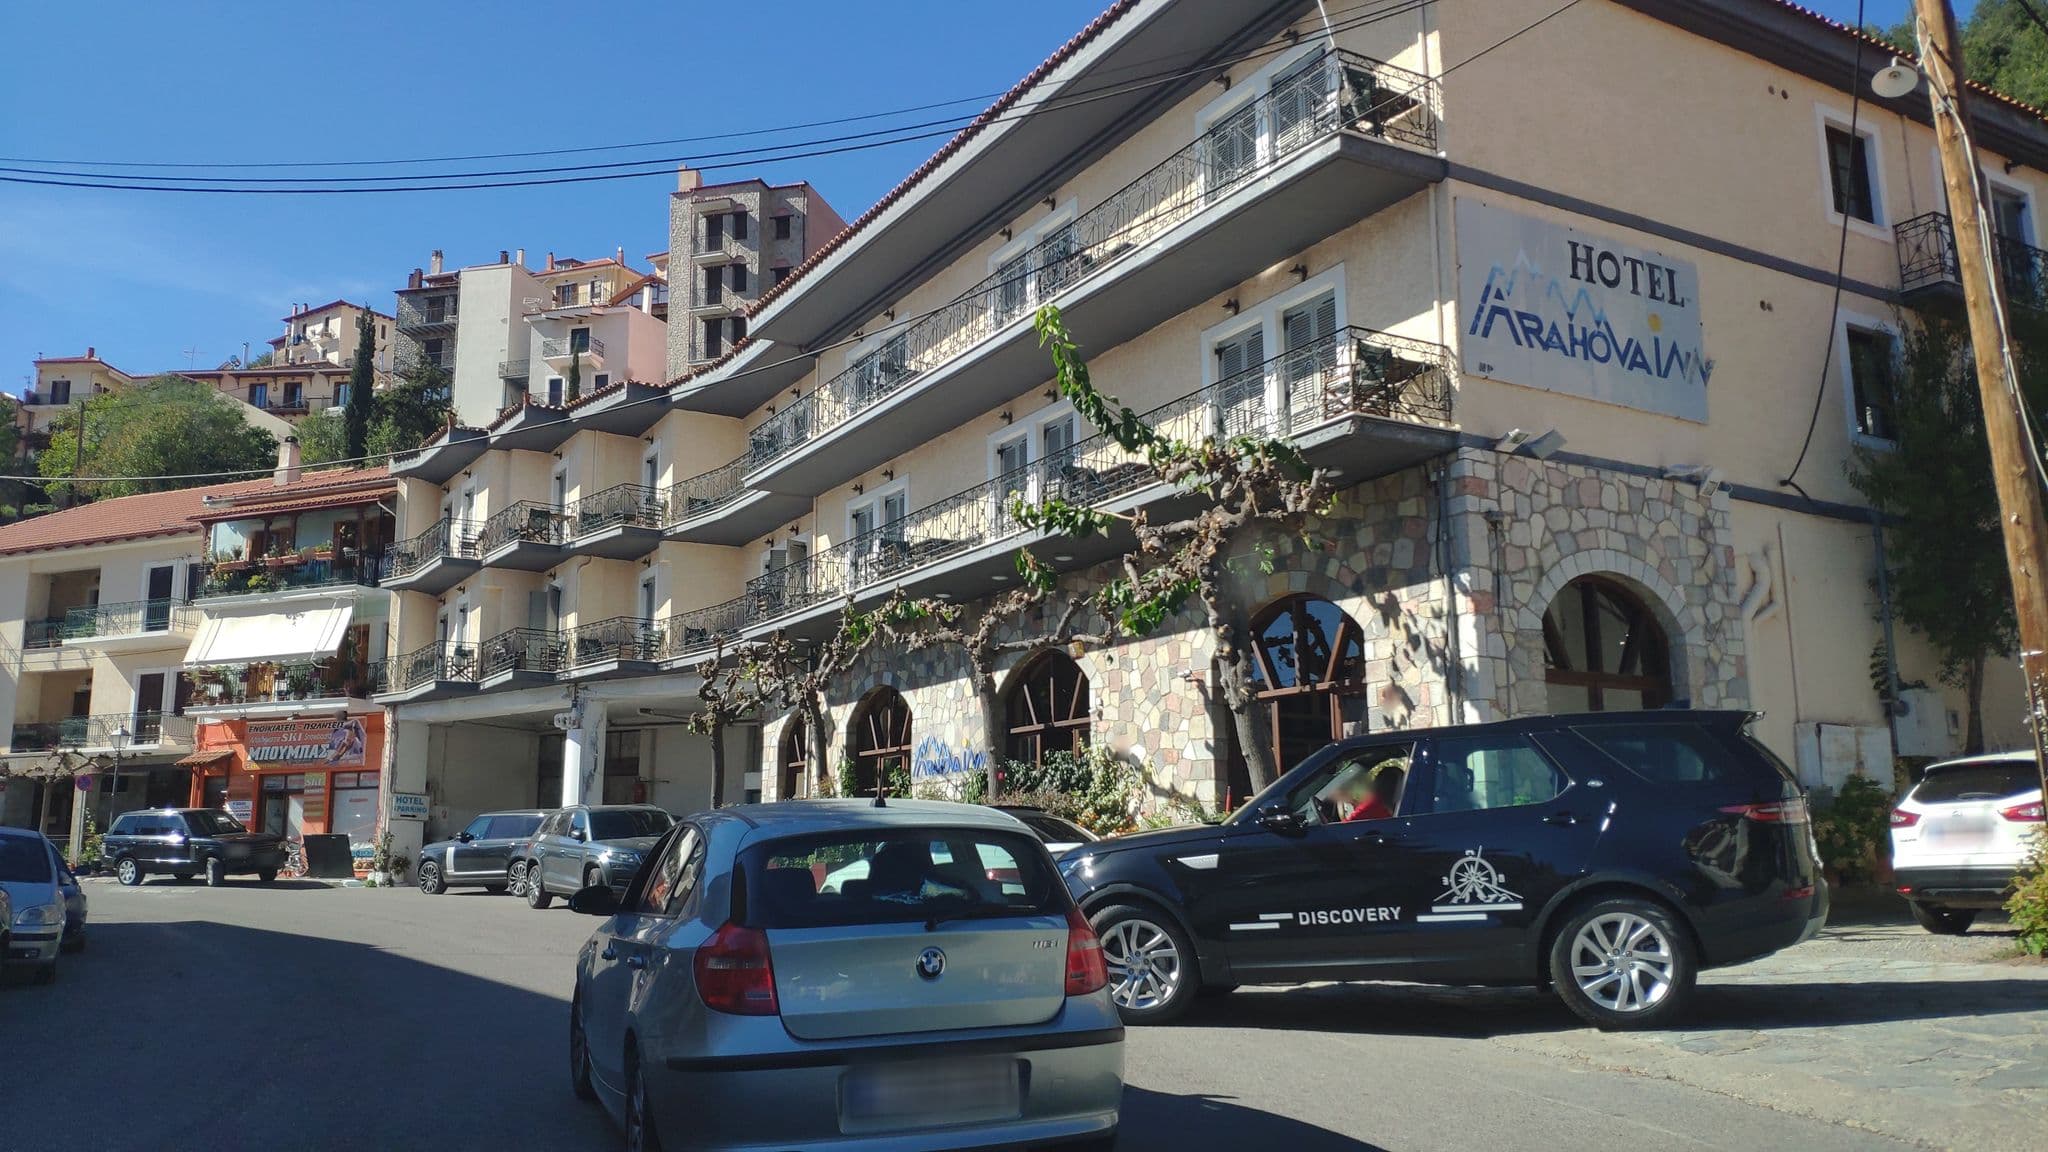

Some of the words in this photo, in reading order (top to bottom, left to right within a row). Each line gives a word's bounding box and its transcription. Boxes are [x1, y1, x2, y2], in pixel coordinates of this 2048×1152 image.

[1567, 240, 1685, 308] HOTEL
[1468, 286, 1653, 377] ARAHOVA
[248, 723, 297, 733] ΕΝΟΙΚΙΑΣΕΙΣ
[303, 721, 344, 731] ΠΩΛΗΣΕΙΣ
[281, 732, 302, 742] SKI
[248, 743, 330, 761] ΜΠΟΥΜΠΑΣ
[396, 796, 423, 805] HOTEL
[1298, 906, 1402, 926] DISCOVERY
